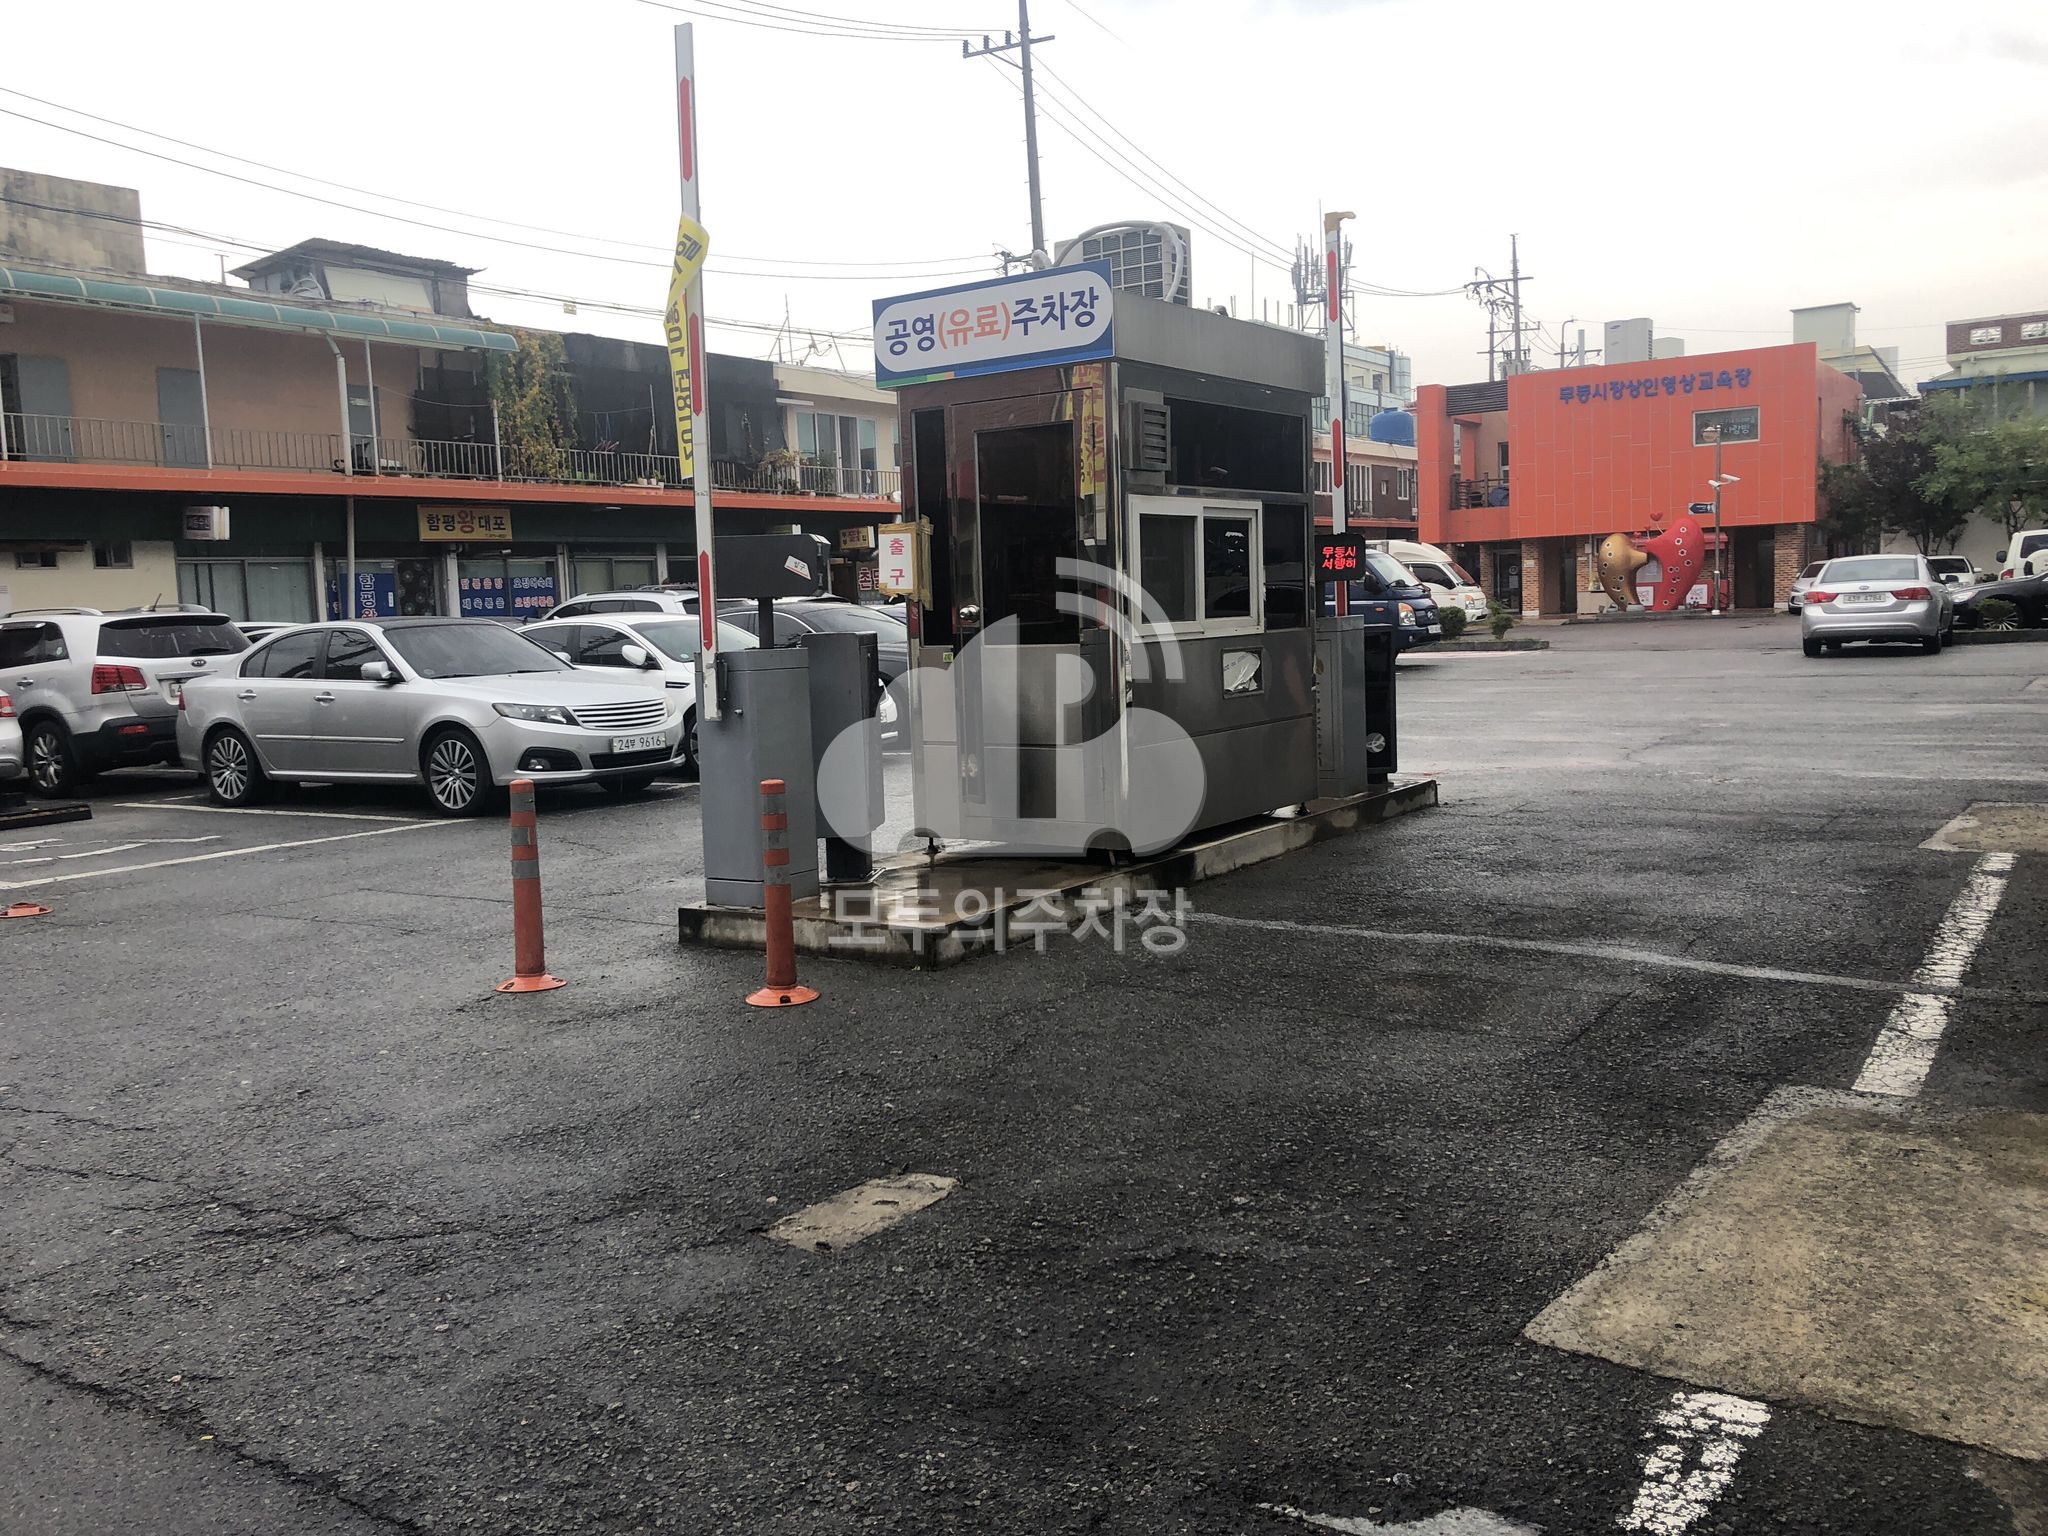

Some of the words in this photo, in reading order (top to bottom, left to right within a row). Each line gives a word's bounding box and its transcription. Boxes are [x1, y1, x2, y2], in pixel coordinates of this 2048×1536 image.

[885, 287, 1099, 356] 공영(유료)주차장
[426, 510, 507, 534] 함평왕대포
[889, 537, 906, 586] 출구
[639, 735, 661, 748] 9616
